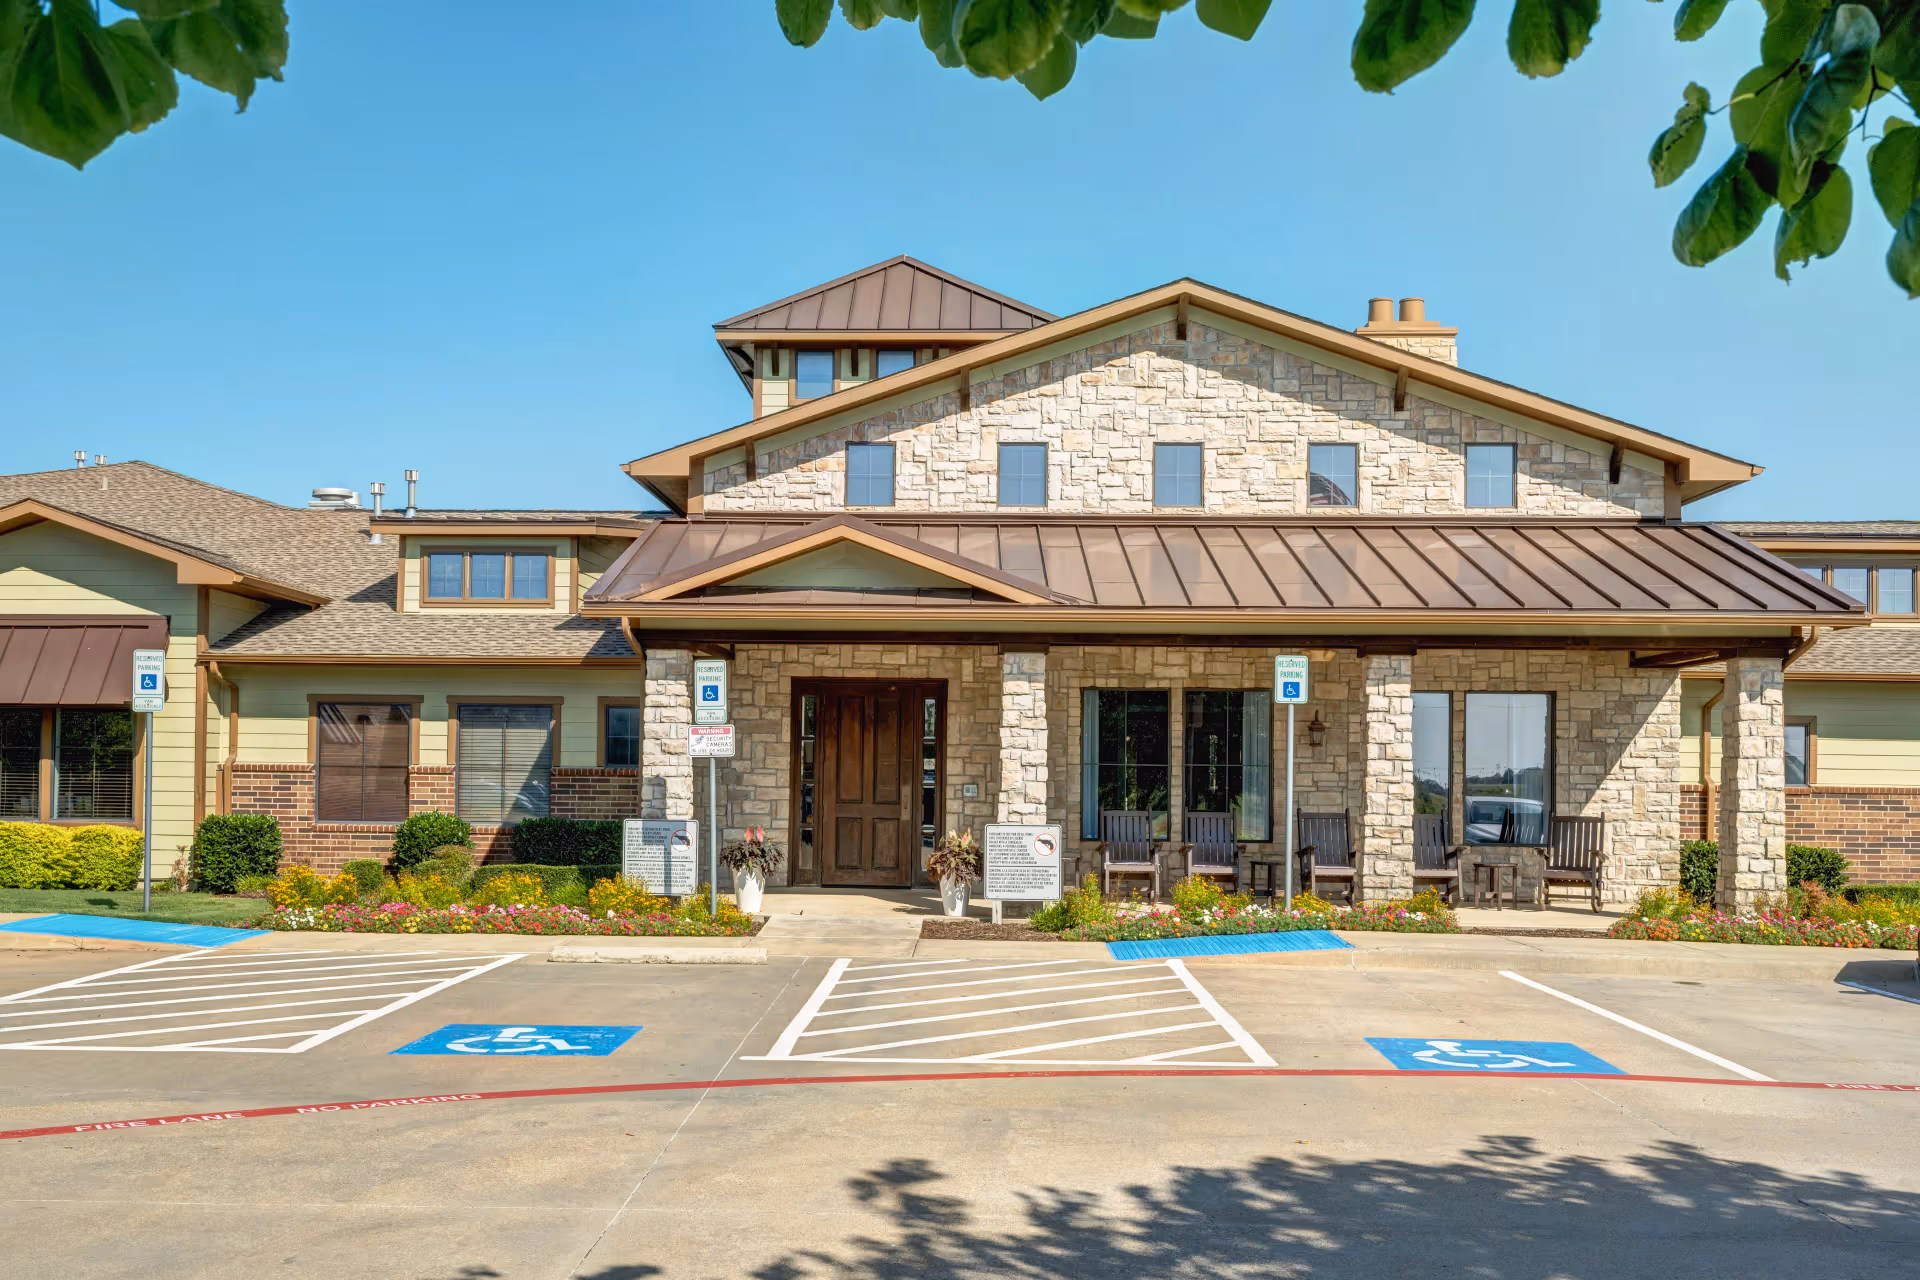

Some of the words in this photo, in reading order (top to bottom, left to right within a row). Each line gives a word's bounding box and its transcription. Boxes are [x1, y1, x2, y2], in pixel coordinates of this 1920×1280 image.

[1278, 660, 1305, 669] RESERVED
[1280, 670, 1304, 679] PARKING
[74, 1120, 150, 1132] FIRE
[158, 1112, 246, 1125] LANE
[297, 1105, 342, 1114] NO
[351, 1093, 483, 1110] PARKING
